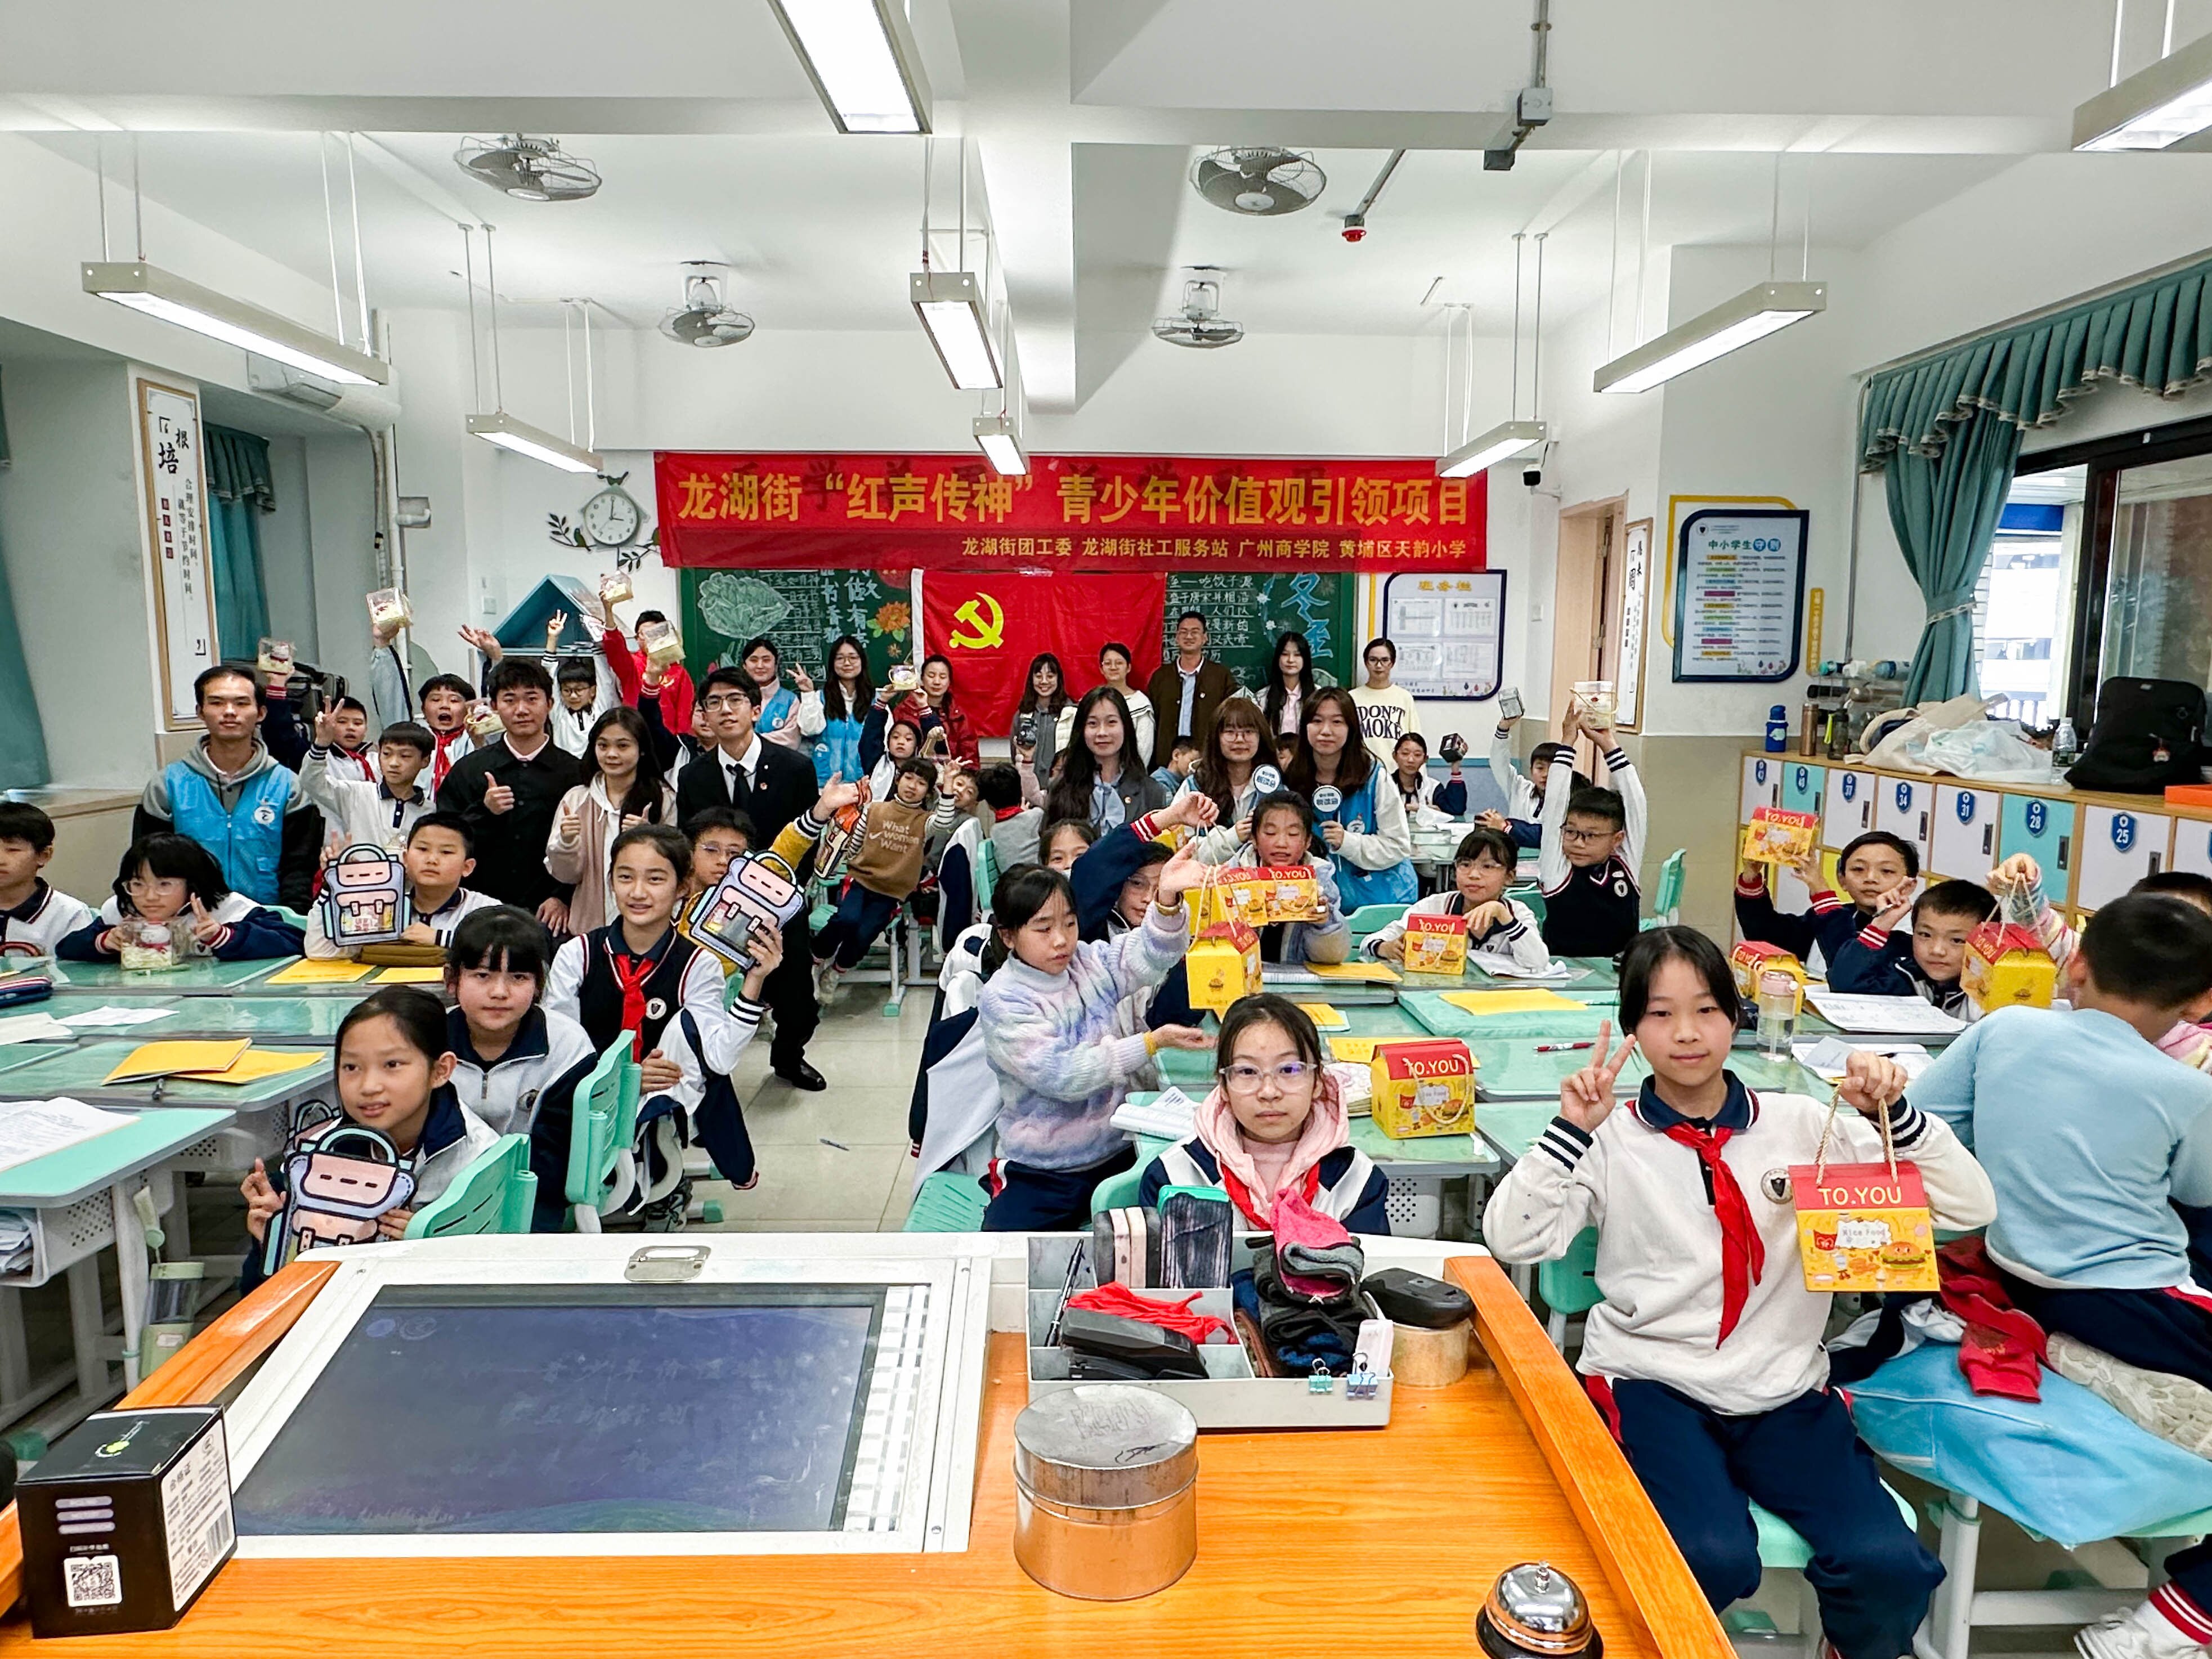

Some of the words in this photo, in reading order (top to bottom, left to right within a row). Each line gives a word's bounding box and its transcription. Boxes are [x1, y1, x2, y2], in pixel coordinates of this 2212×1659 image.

[962, 537, 1072, 556] 龙湖街团工委
[1082, 537, 1229, 558] 龙湖街社工服务站
[1238, 538, 1329, 558] 广州商学院
[1339, 538, 1466, 558] 黄埔区天韵小学
[1708, 538, 1781, 552] 中小学生守则
[1280, 572, 1333, 658] 冬至
[1899, 794, 1907, 806] 34
[1961, 804, 1970, 817] 31
[2030, 815, 2041, 830] 28
[2116, 828, 2129, 844] 25
[1818, 1186, 1902, 1205] TO.YOU
